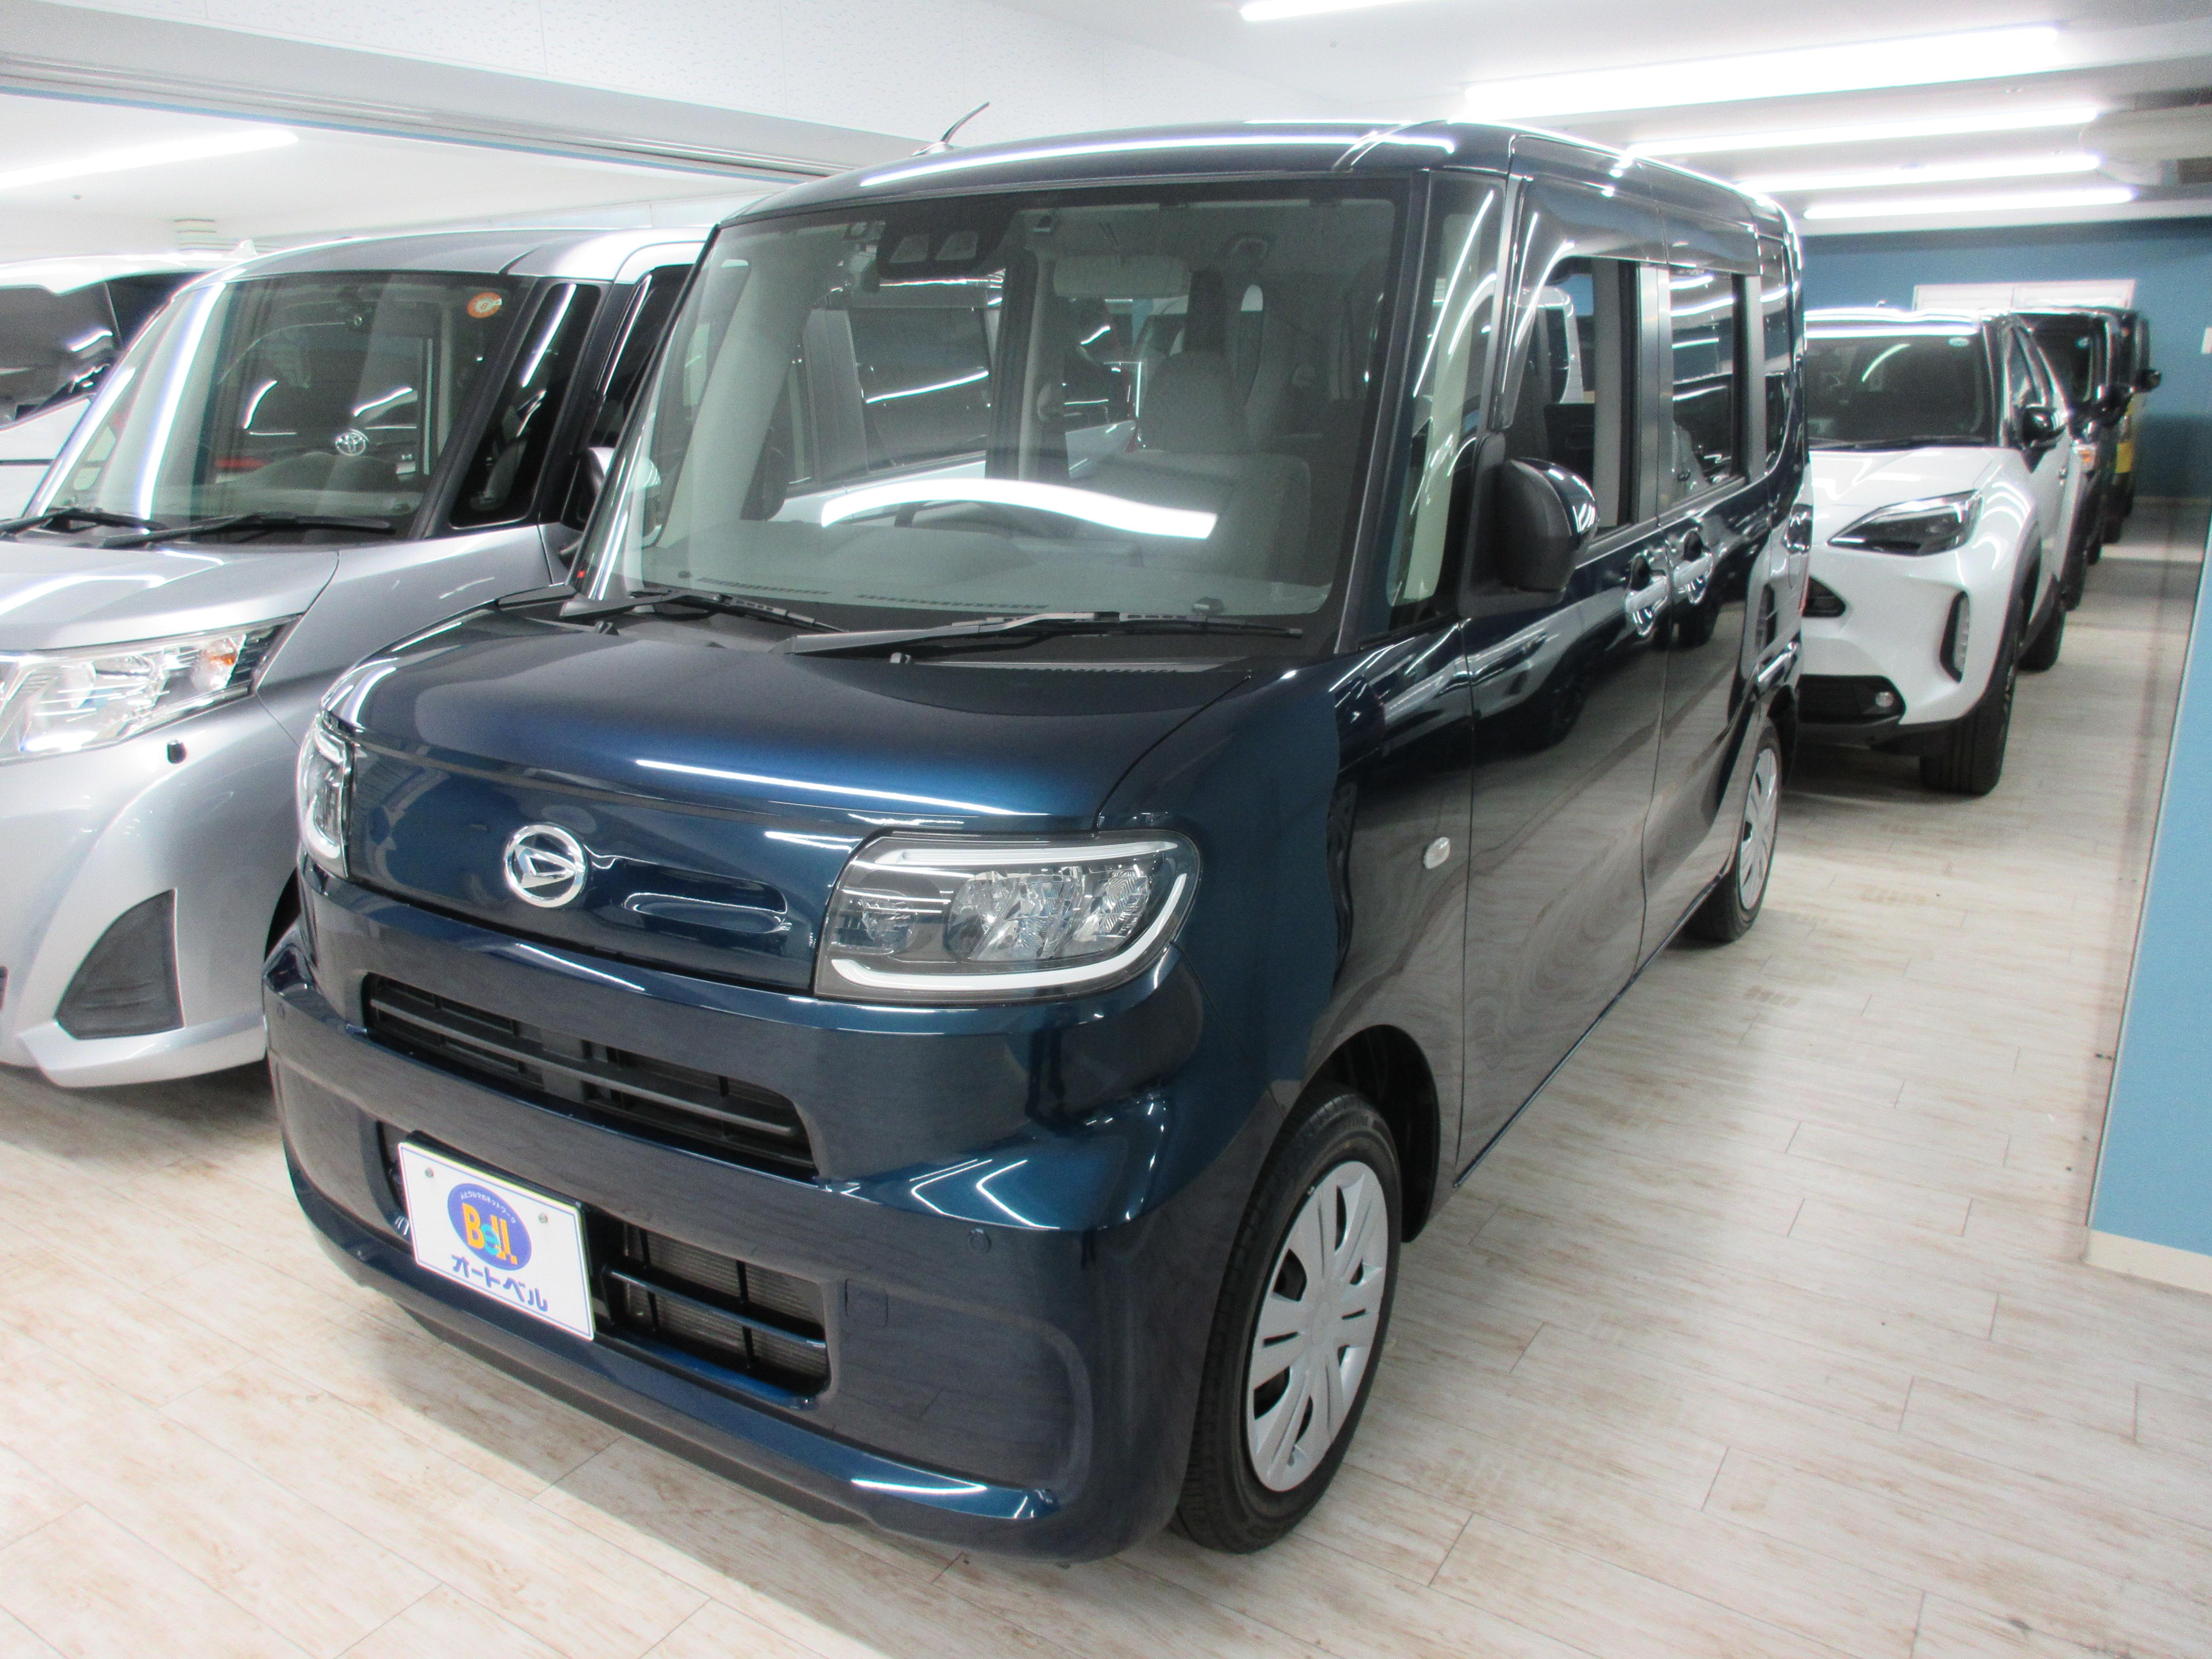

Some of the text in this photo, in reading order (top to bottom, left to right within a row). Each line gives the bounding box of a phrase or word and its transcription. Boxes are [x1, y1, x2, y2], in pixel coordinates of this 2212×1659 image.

[451, 1254, 548, 1312] オートベル
